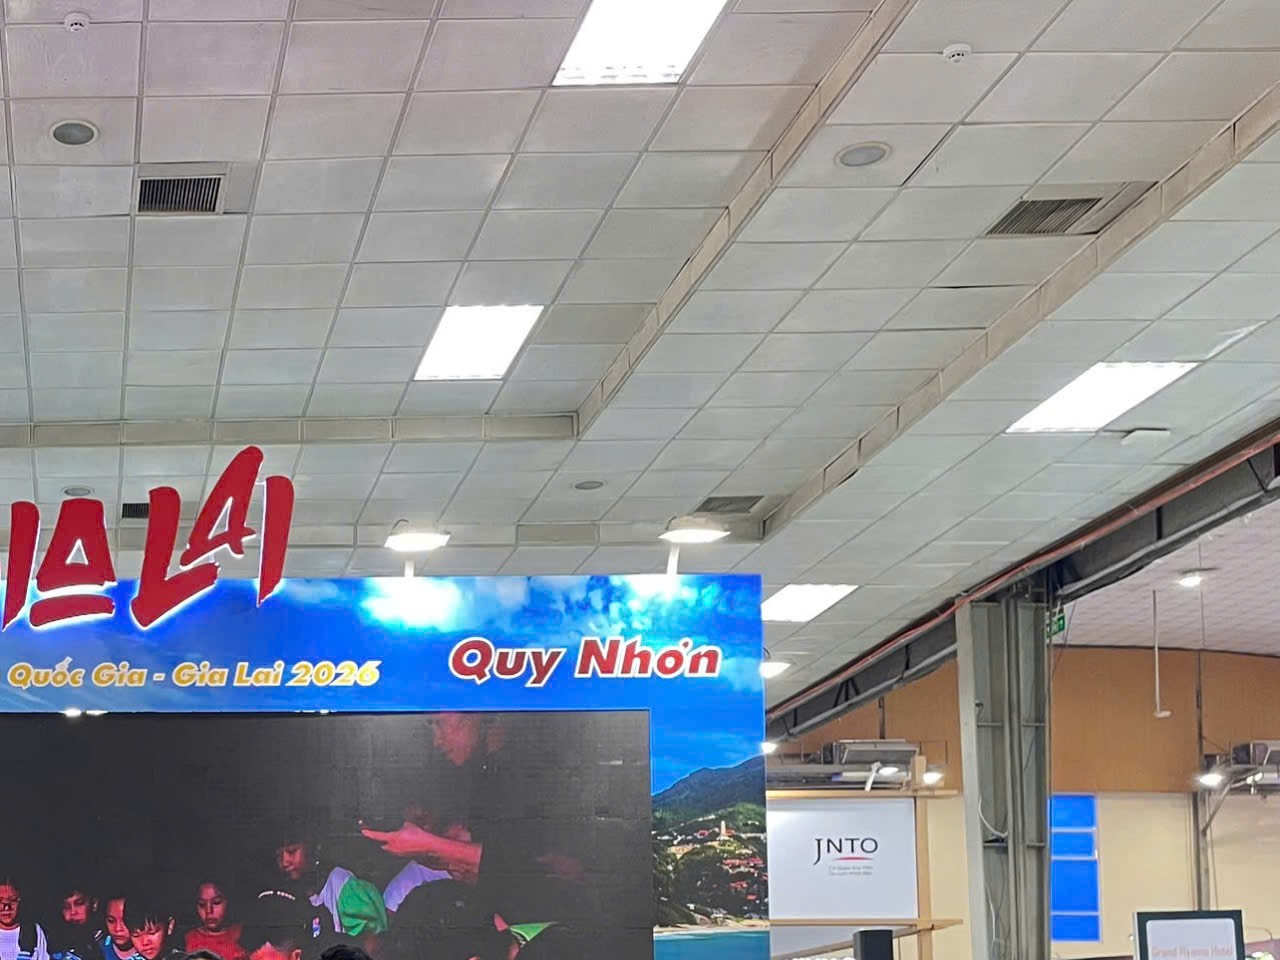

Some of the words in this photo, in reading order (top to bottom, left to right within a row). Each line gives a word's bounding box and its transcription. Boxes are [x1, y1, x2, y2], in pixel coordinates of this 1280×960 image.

[130, 445, 294, 628] LAI
[7, 657, 85, 690] Quốc
[92, 661, 147, 686] Gia
[172, 661, 229, 687] Gia
[233, 661, 285, 687] Lai
[285, 661, 382, 687] 2026
[449, 636, 566, 687] Quy
[574, 636, 720, 678] Nhơn
[813, 838, 878, 865] JNTO
